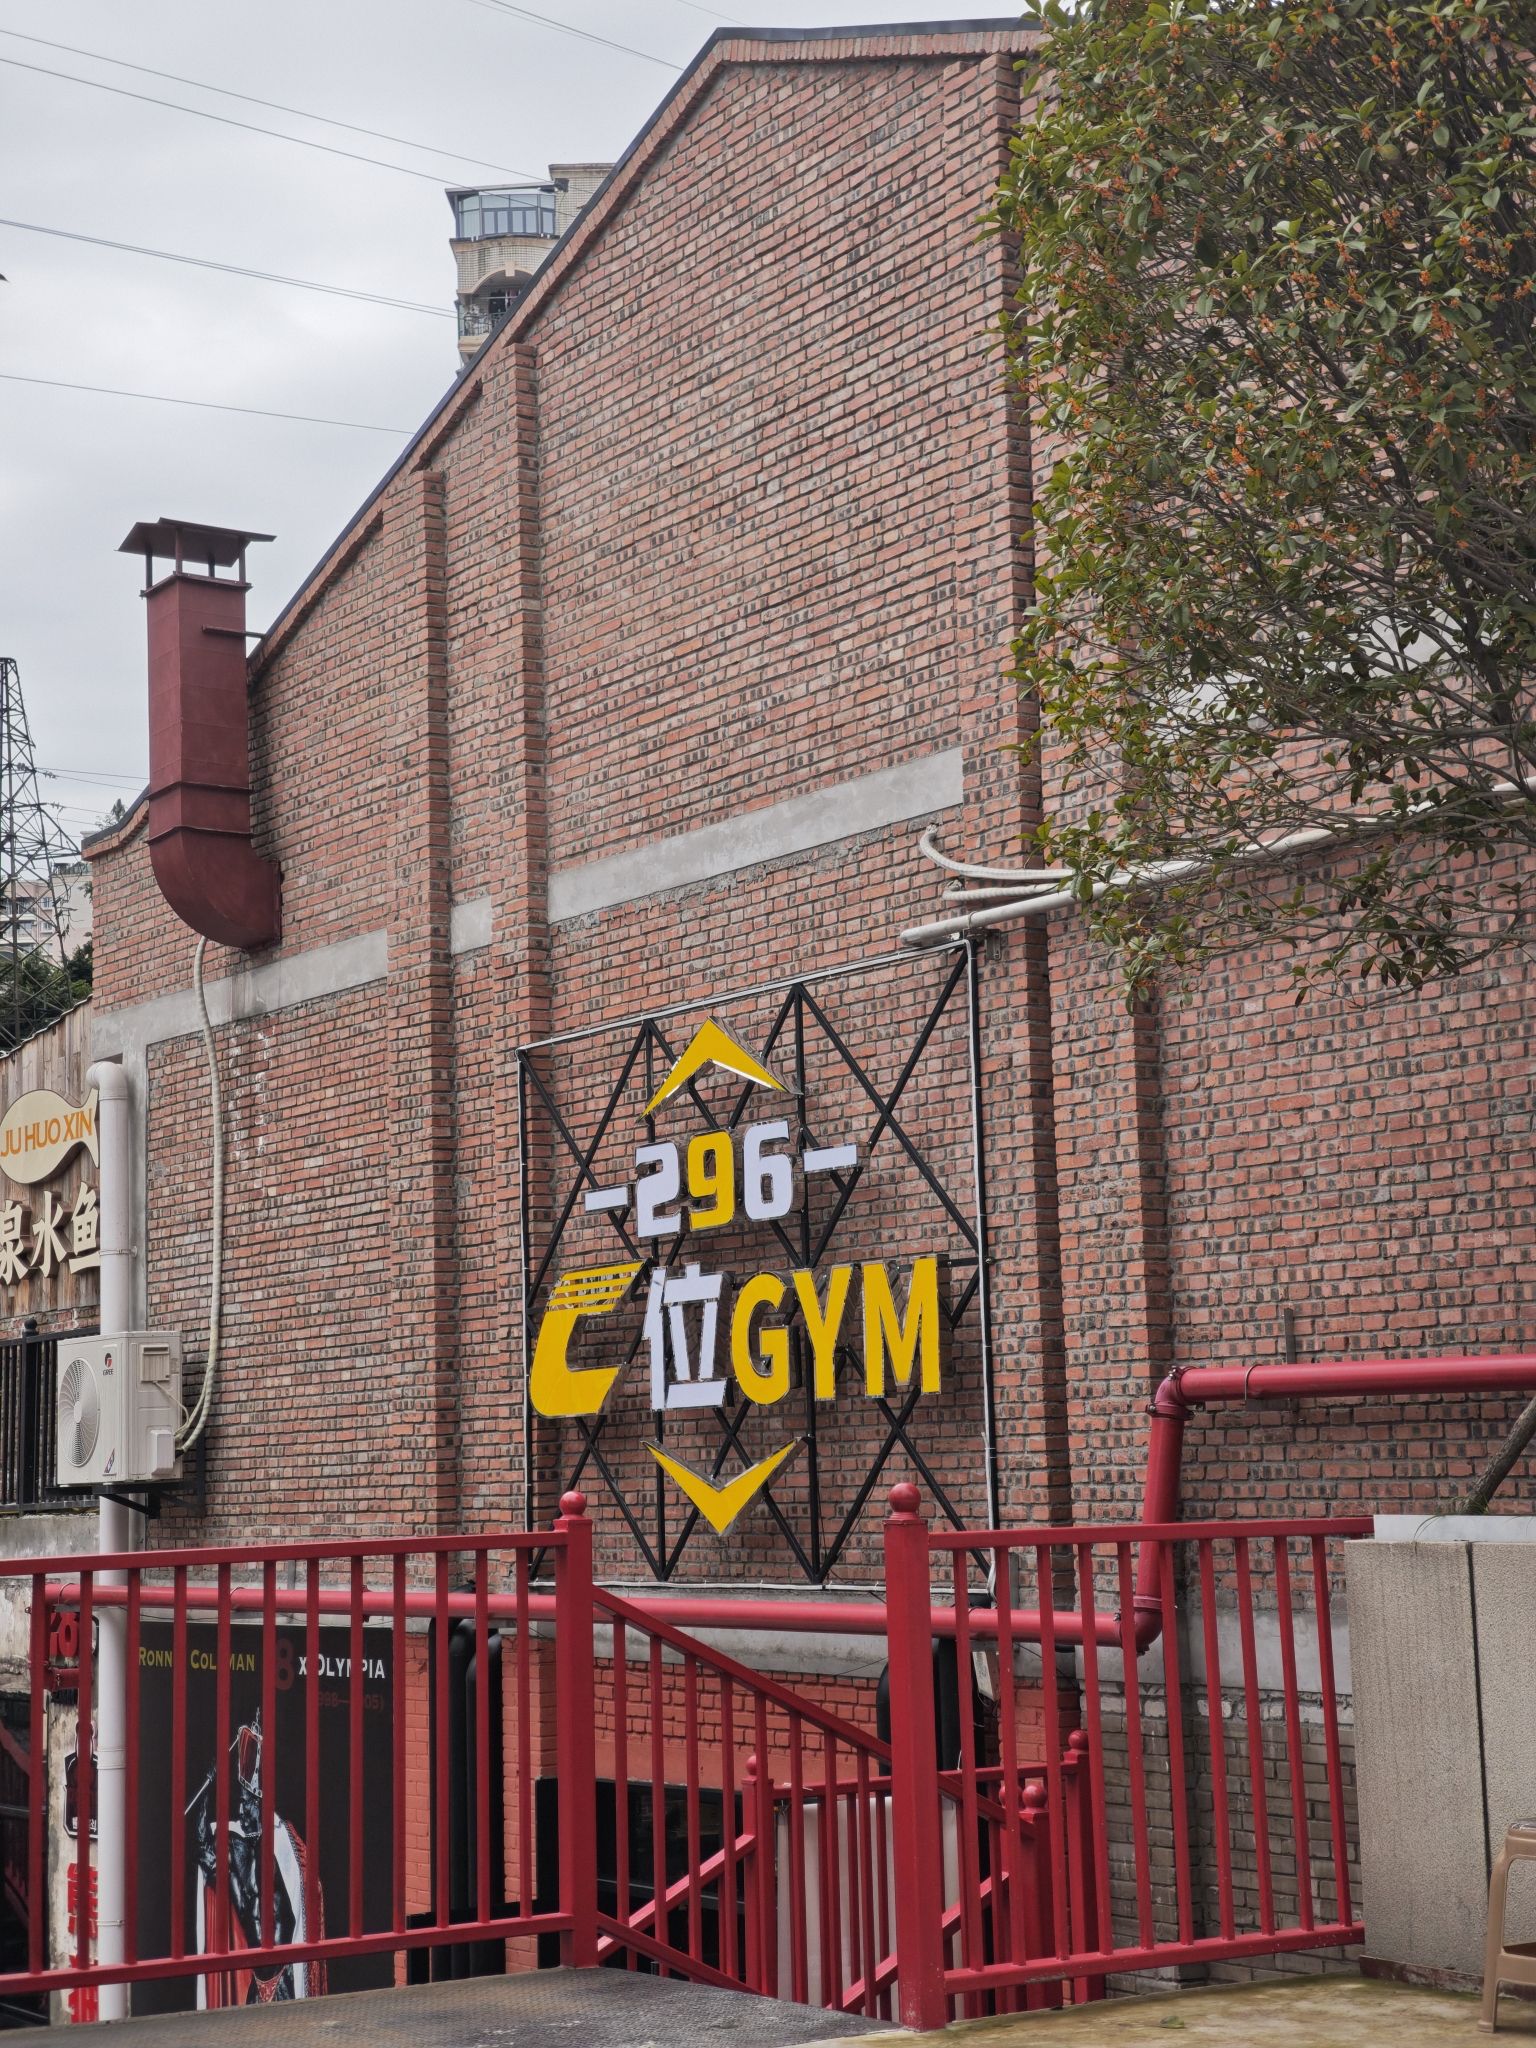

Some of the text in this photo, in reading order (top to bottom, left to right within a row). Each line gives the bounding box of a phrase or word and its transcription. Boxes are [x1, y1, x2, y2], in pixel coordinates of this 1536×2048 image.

[0, 1108, 93, 1157] JU HUO XIN
[138, 1647, 255, 1672] RONN COLMAN
